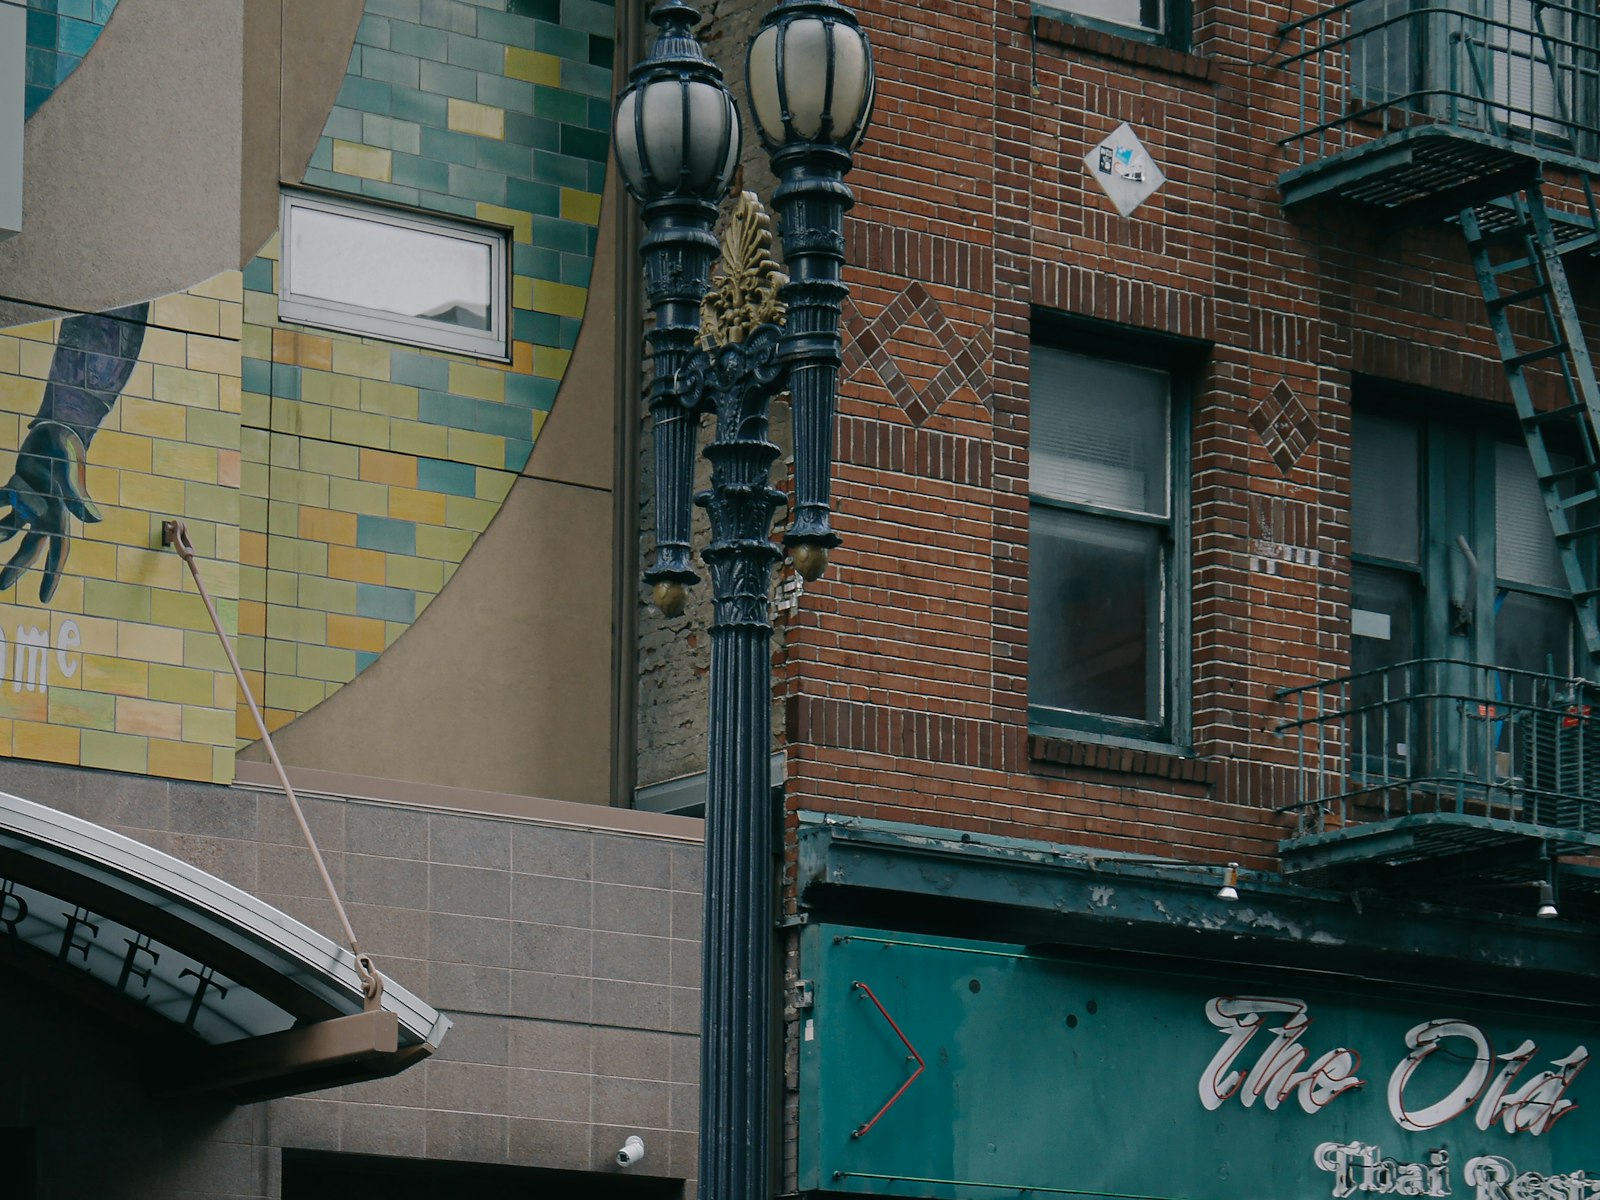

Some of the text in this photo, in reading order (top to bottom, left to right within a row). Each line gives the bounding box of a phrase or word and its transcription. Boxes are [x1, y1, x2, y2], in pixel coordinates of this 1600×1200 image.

[1199, 995, 1592, 1136] The Old
[1314, 1140, 1452, 1198] Thai
